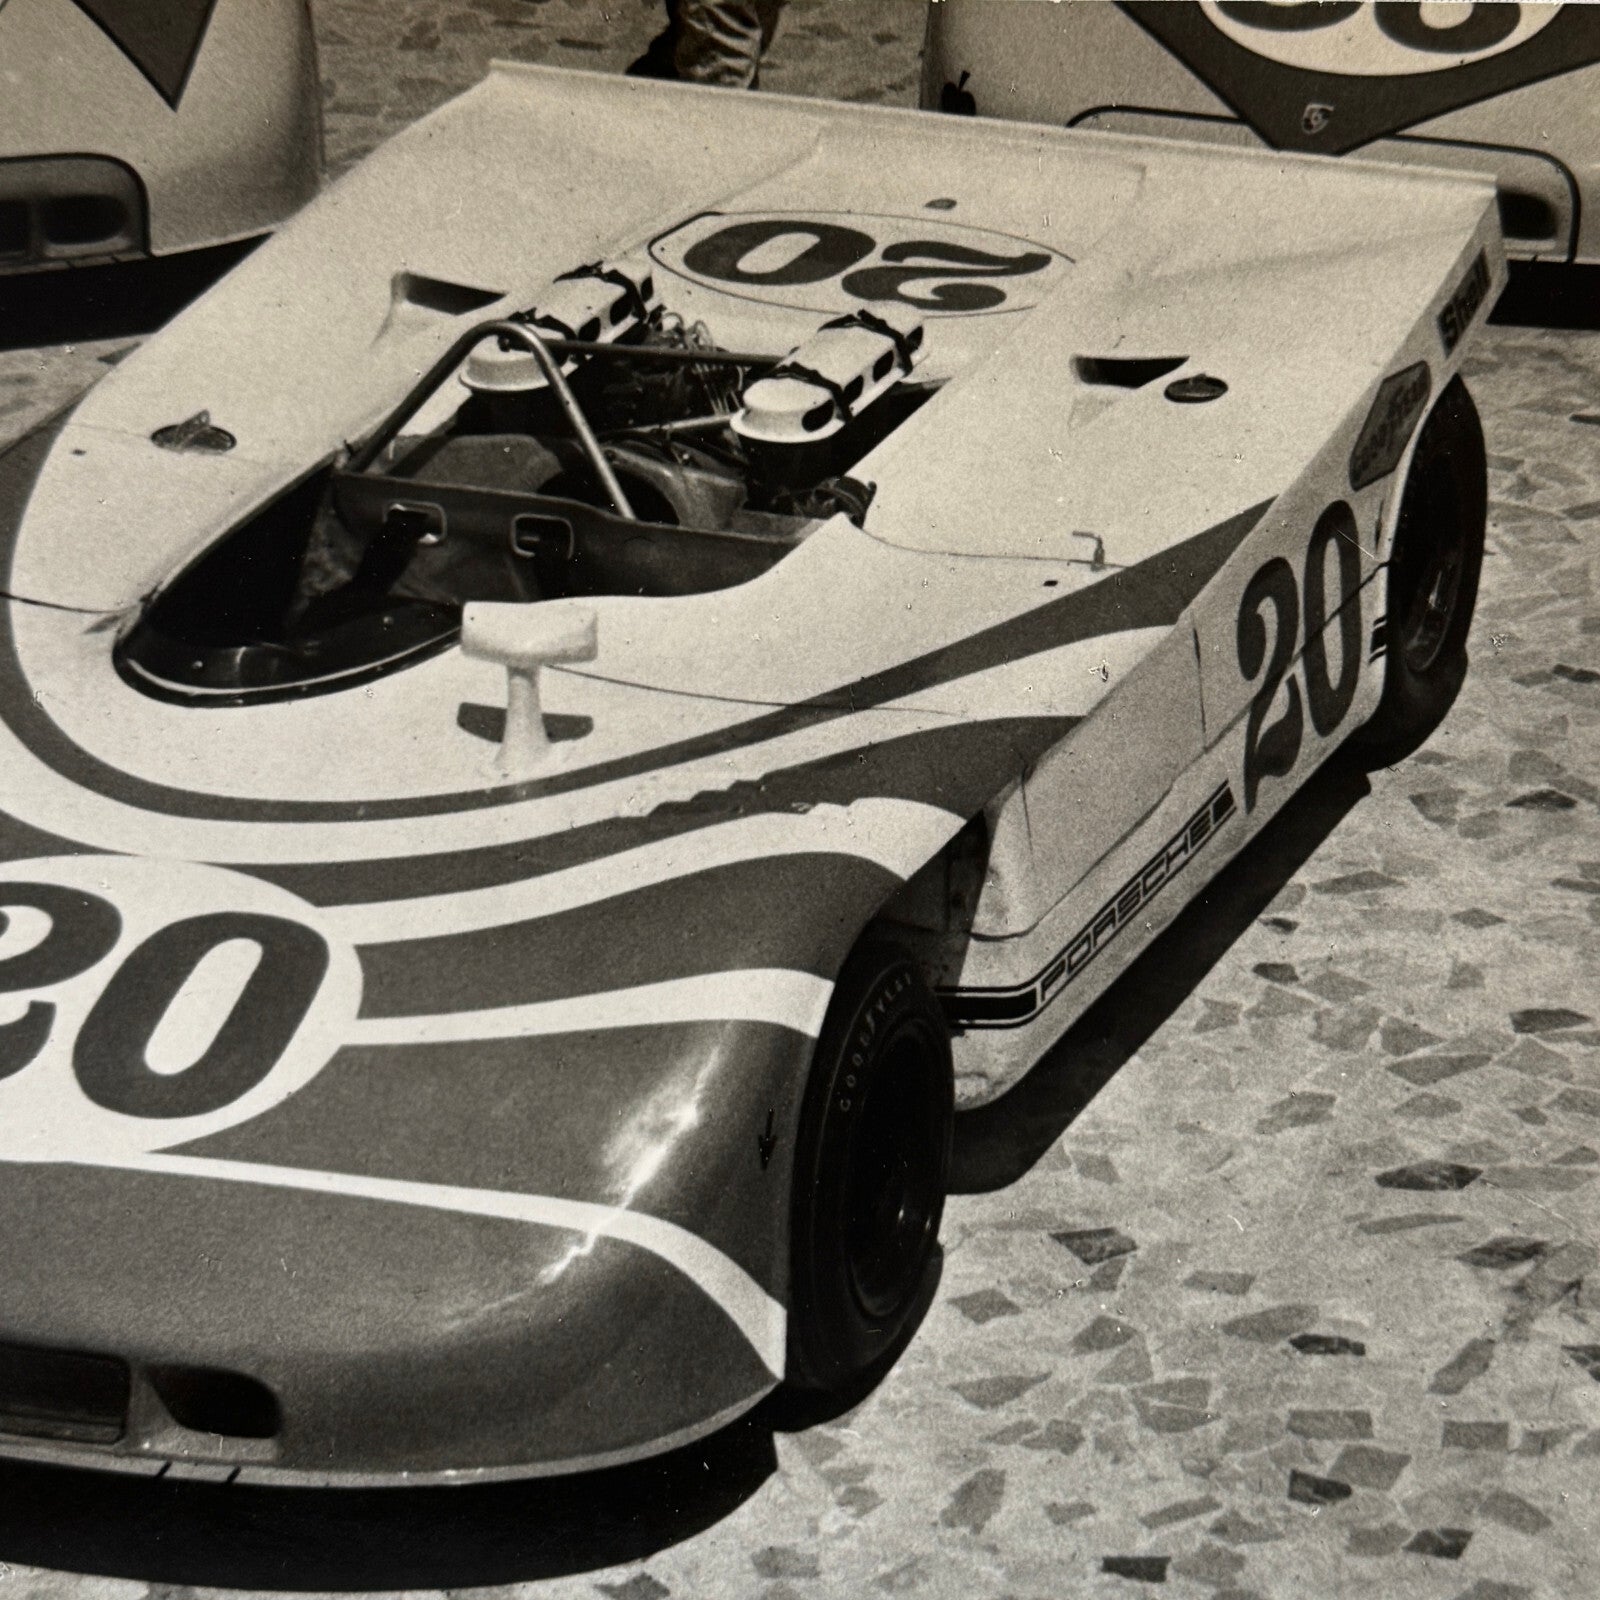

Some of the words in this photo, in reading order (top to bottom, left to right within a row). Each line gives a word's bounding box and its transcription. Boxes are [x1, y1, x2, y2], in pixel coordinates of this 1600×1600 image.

[683, 219, 1052, 311] 20
[1237, 499, 1362, 816] 20
[1041, 808, 1211, 1002] PORSCHE
